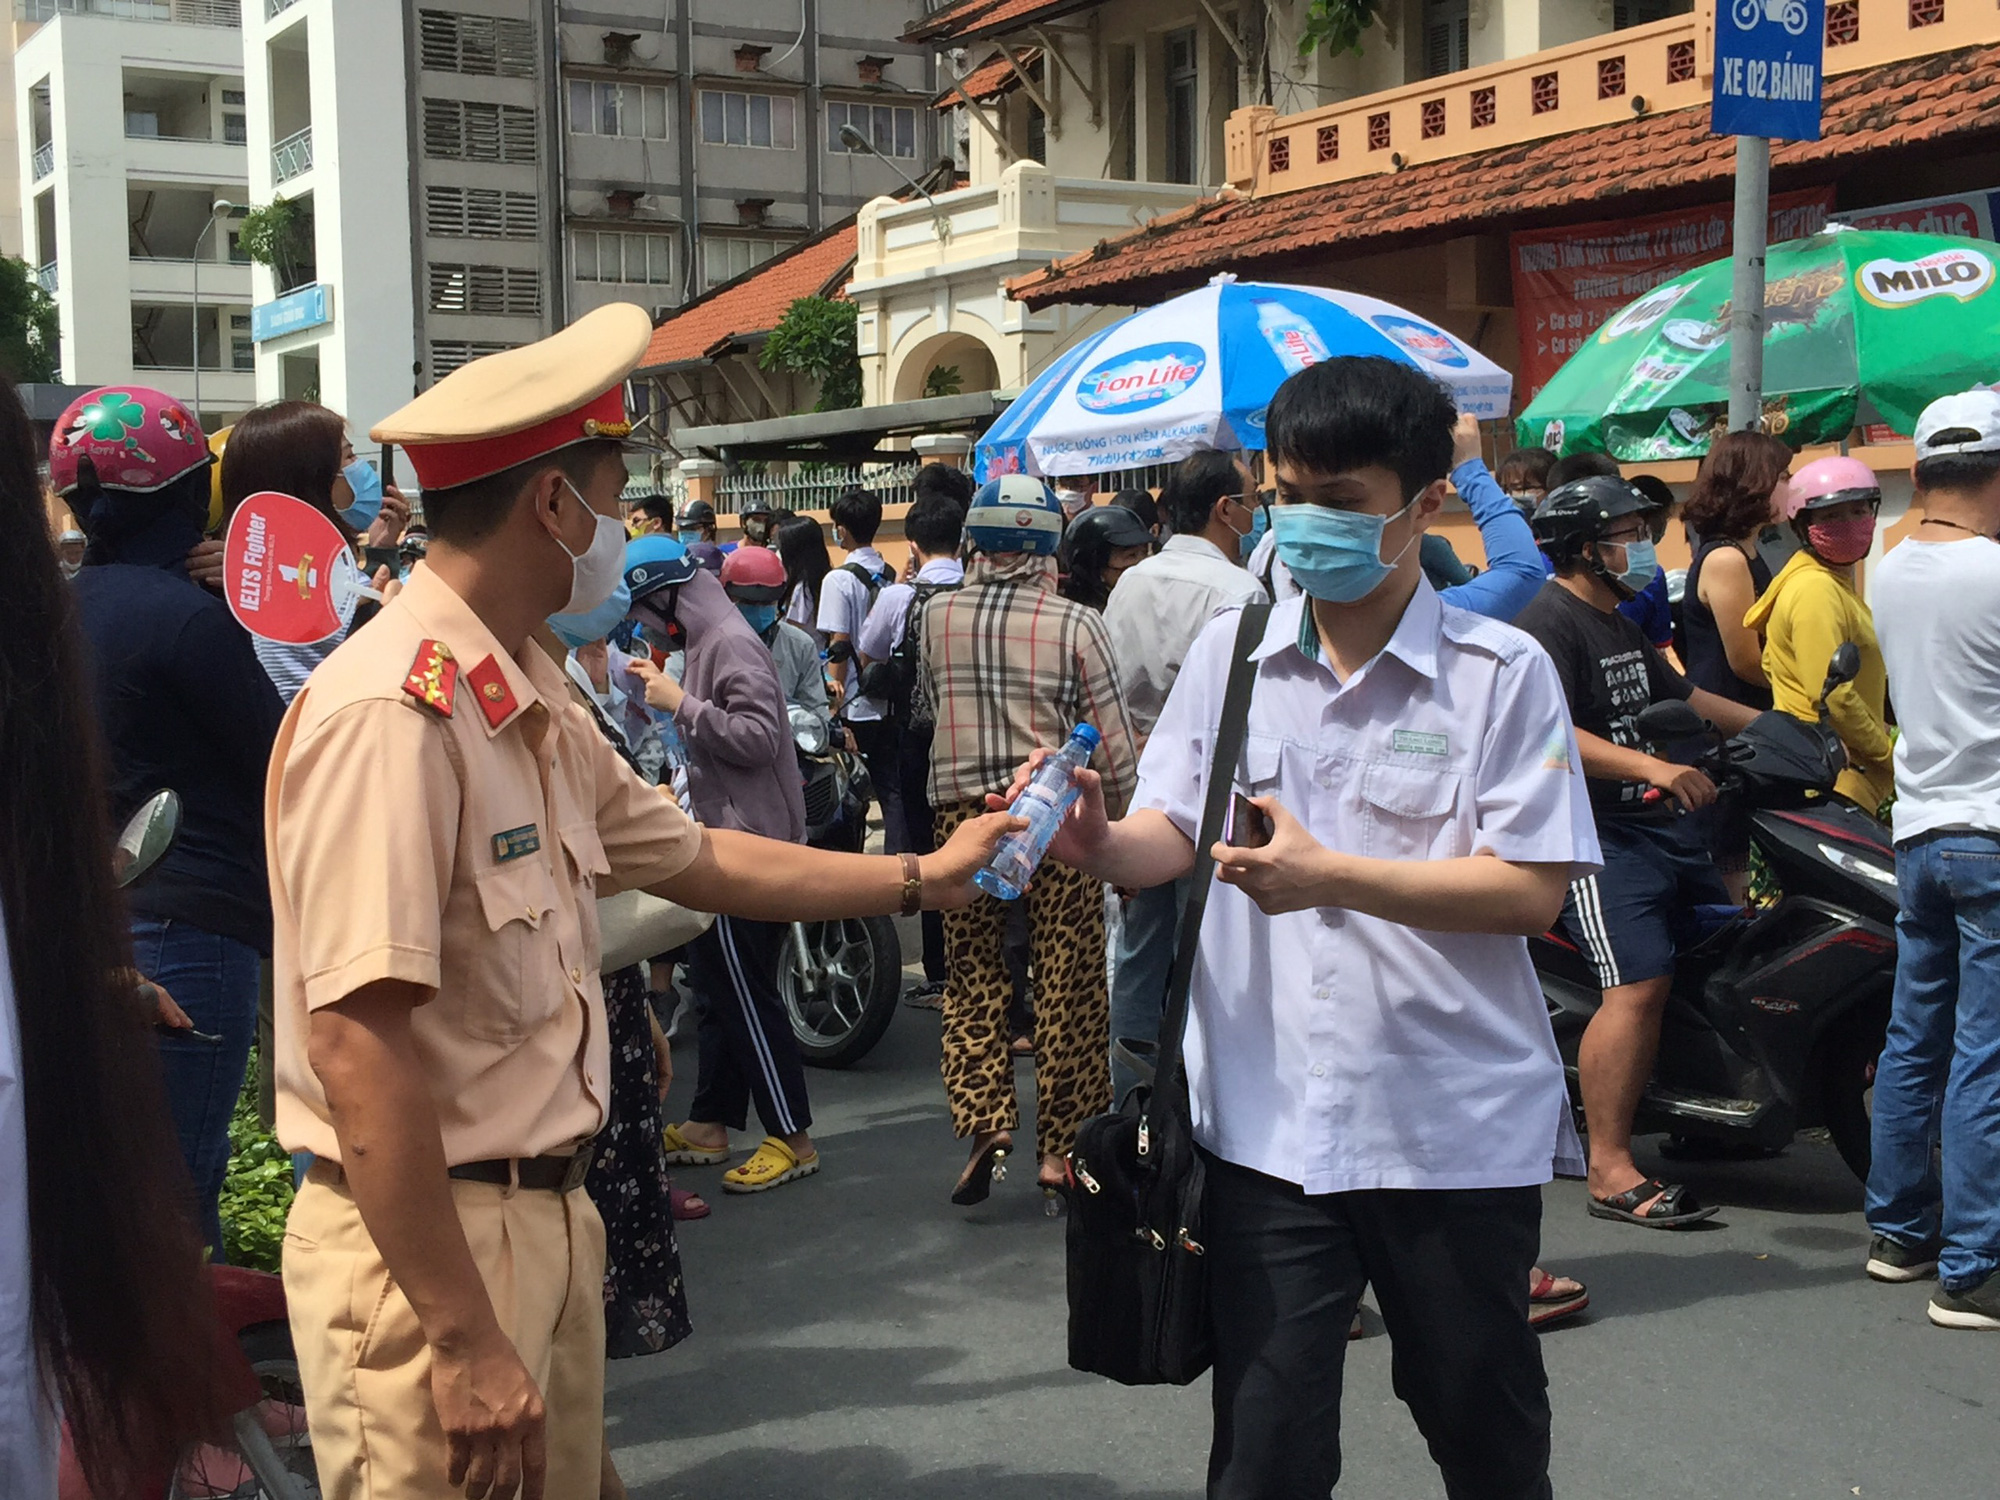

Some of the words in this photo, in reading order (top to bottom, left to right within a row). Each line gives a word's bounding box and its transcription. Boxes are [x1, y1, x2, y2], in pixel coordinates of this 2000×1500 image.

[1722, 57, 1743, 96] XE
[1747, 59, 1767, 98] 02
[1769, 51, 1814, 102] BÁNH
[1871, 261, 1981, 294] MILO
[1096, 371, 1144, 395] i-on
[1147, 363, 1198, 387] Life
[243, 512, 266, 567] Fighter
[239, 568, 262, 611] IELTS
